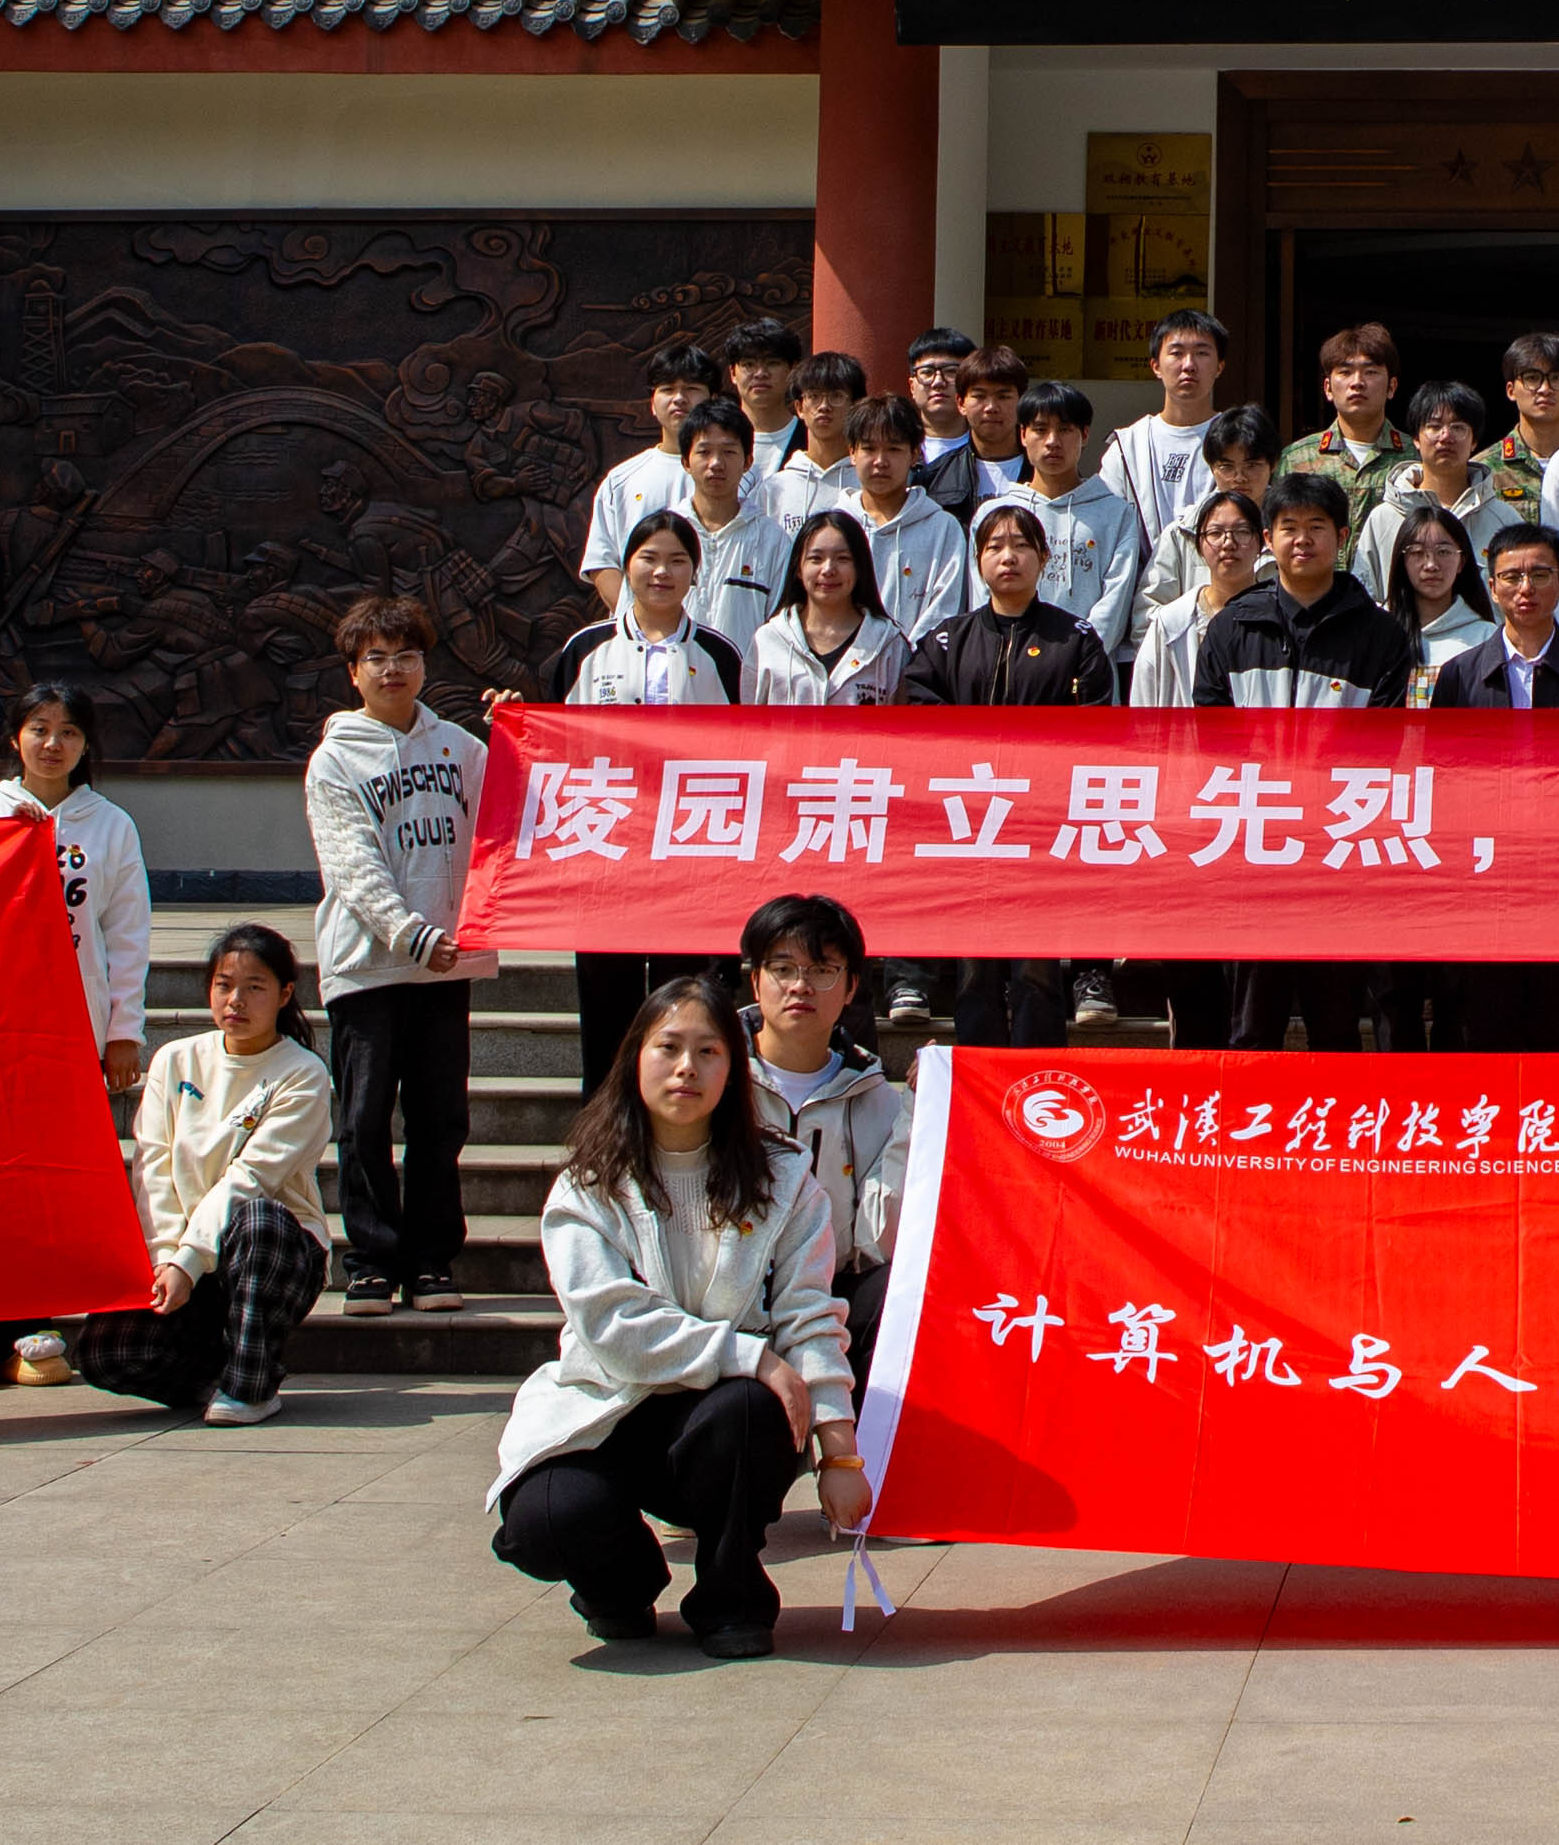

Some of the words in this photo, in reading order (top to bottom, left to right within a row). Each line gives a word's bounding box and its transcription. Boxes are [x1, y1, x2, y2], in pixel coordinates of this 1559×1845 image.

[1115, 1145, 1185, 1165] WUHAN
[1189, 1153, 1308, 1171] UNIVERSITY
[1310, 1158, 1337, 1172] OF
[1340, 1158, 1476, 1173] ENGINEERING
